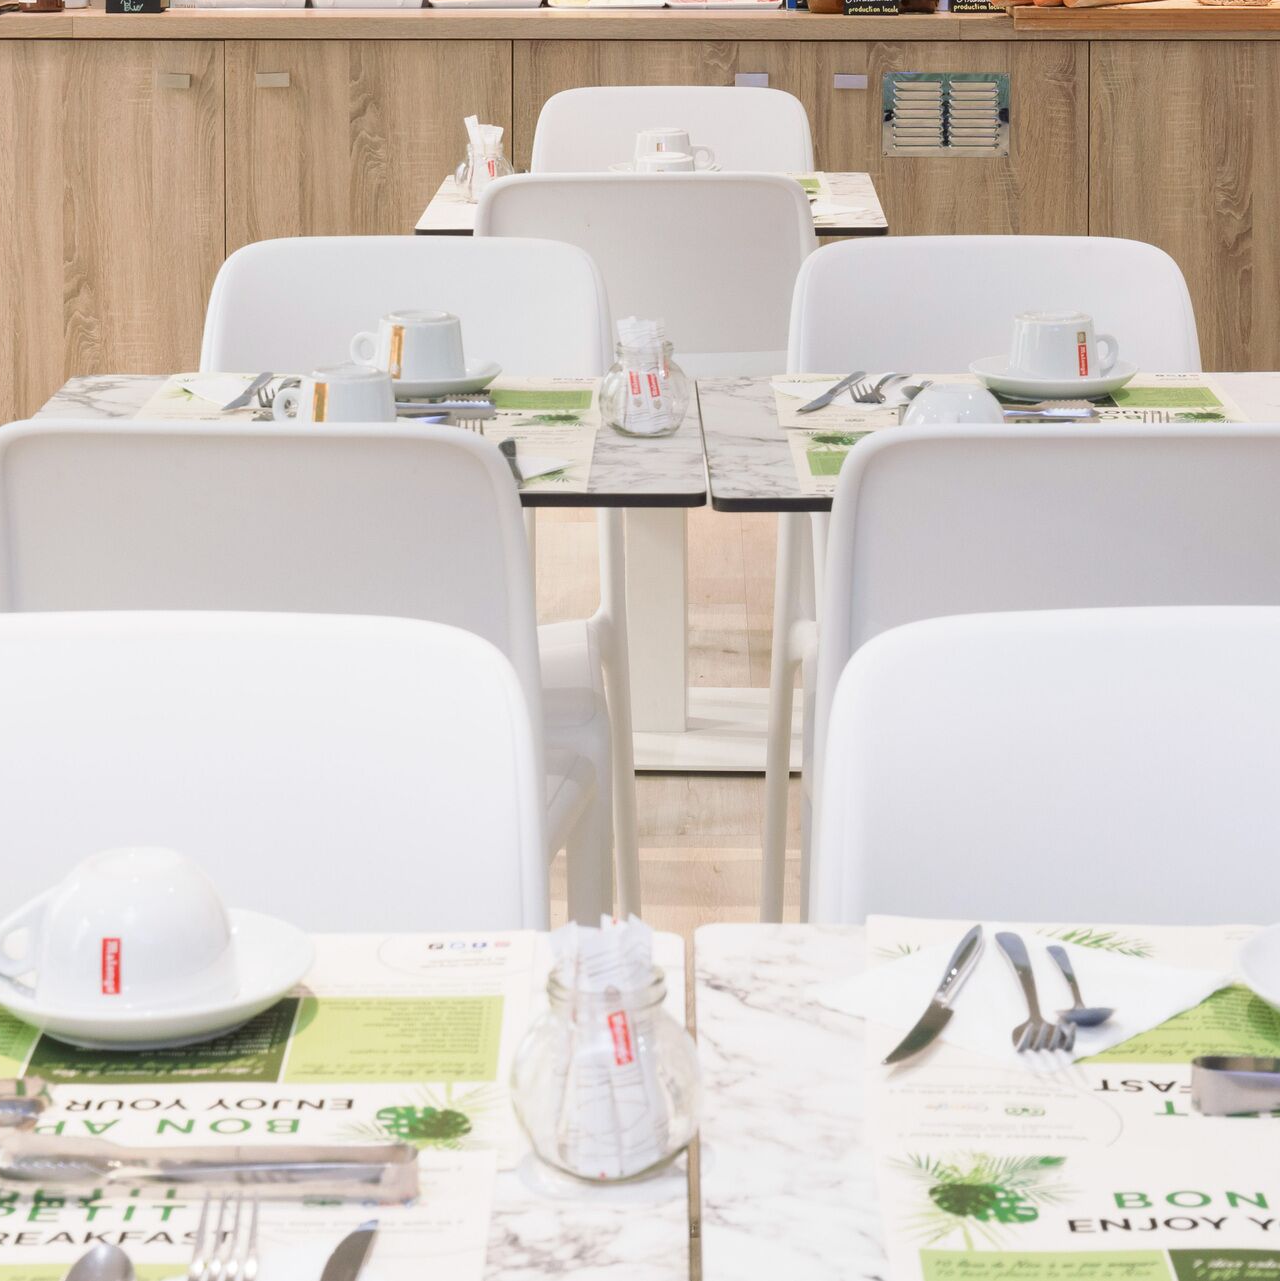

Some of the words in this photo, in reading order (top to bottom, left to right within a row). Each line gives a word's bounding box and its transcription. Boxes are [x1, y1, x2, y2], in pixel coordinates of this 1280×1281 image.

[848, 5, 881, 14] production
[953, 4, 987, 12] production
[1079, 346, 1087, 375] Malongo
[105, 940, 118, 993] Malongo
[65, 1098, 187, 1112] YOUR
[204, 1098, 354, 1112] ENJOY
[155, 1118, 300, 1135] BON
[1113, 1190, 1269, 1209] BON
[1067, 1216, 1229, 1232] ENJOY
